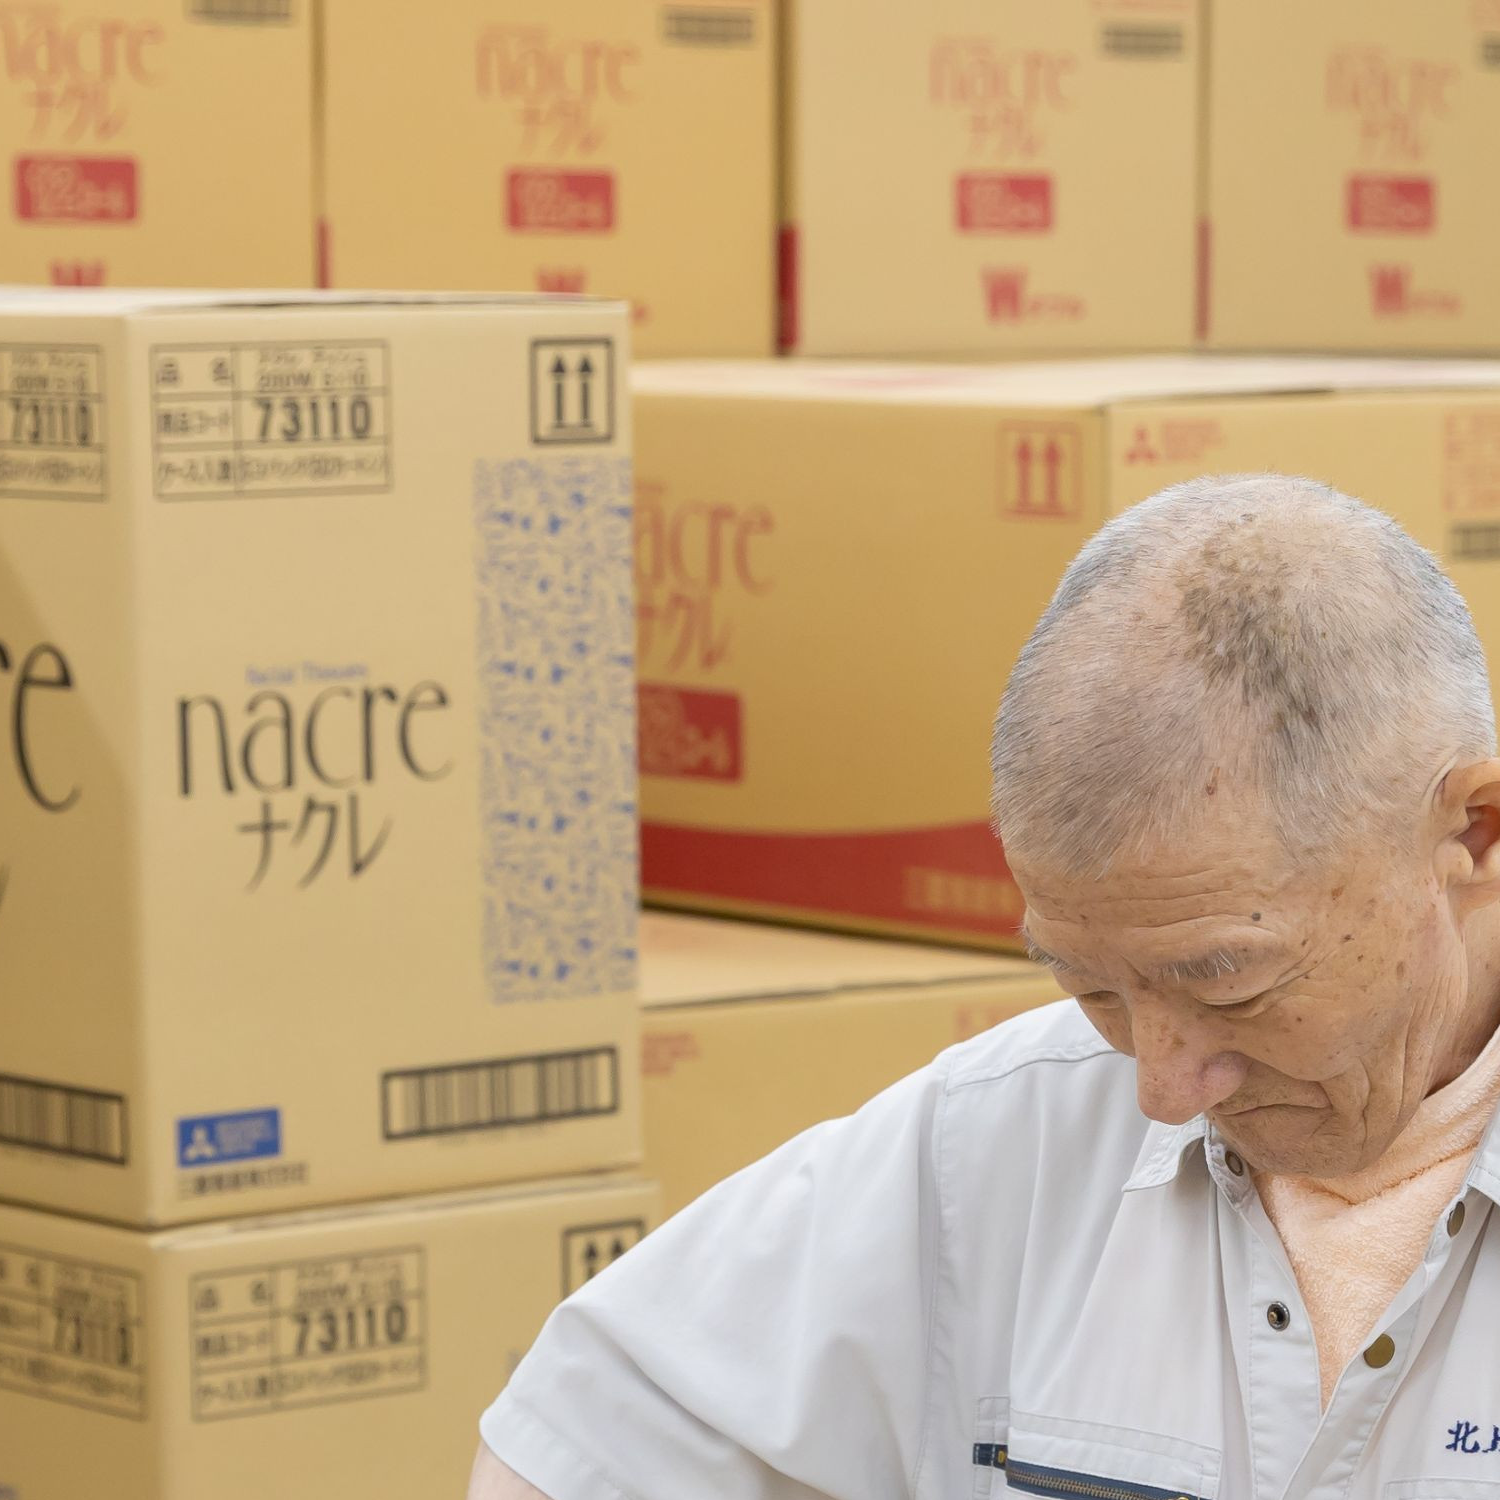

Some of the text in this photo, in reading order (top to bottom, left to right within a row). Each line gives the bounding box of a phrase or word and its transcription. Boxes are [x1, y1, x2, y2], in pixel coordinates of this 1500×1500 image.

[254, 396, 374, 443] 73110
[634, 500, 776, 596] acre
[176, 680, 456, 800] nacre
[237, 790, 394, 893] ナクレ
[292, 1302, 408, 1358] 73110
